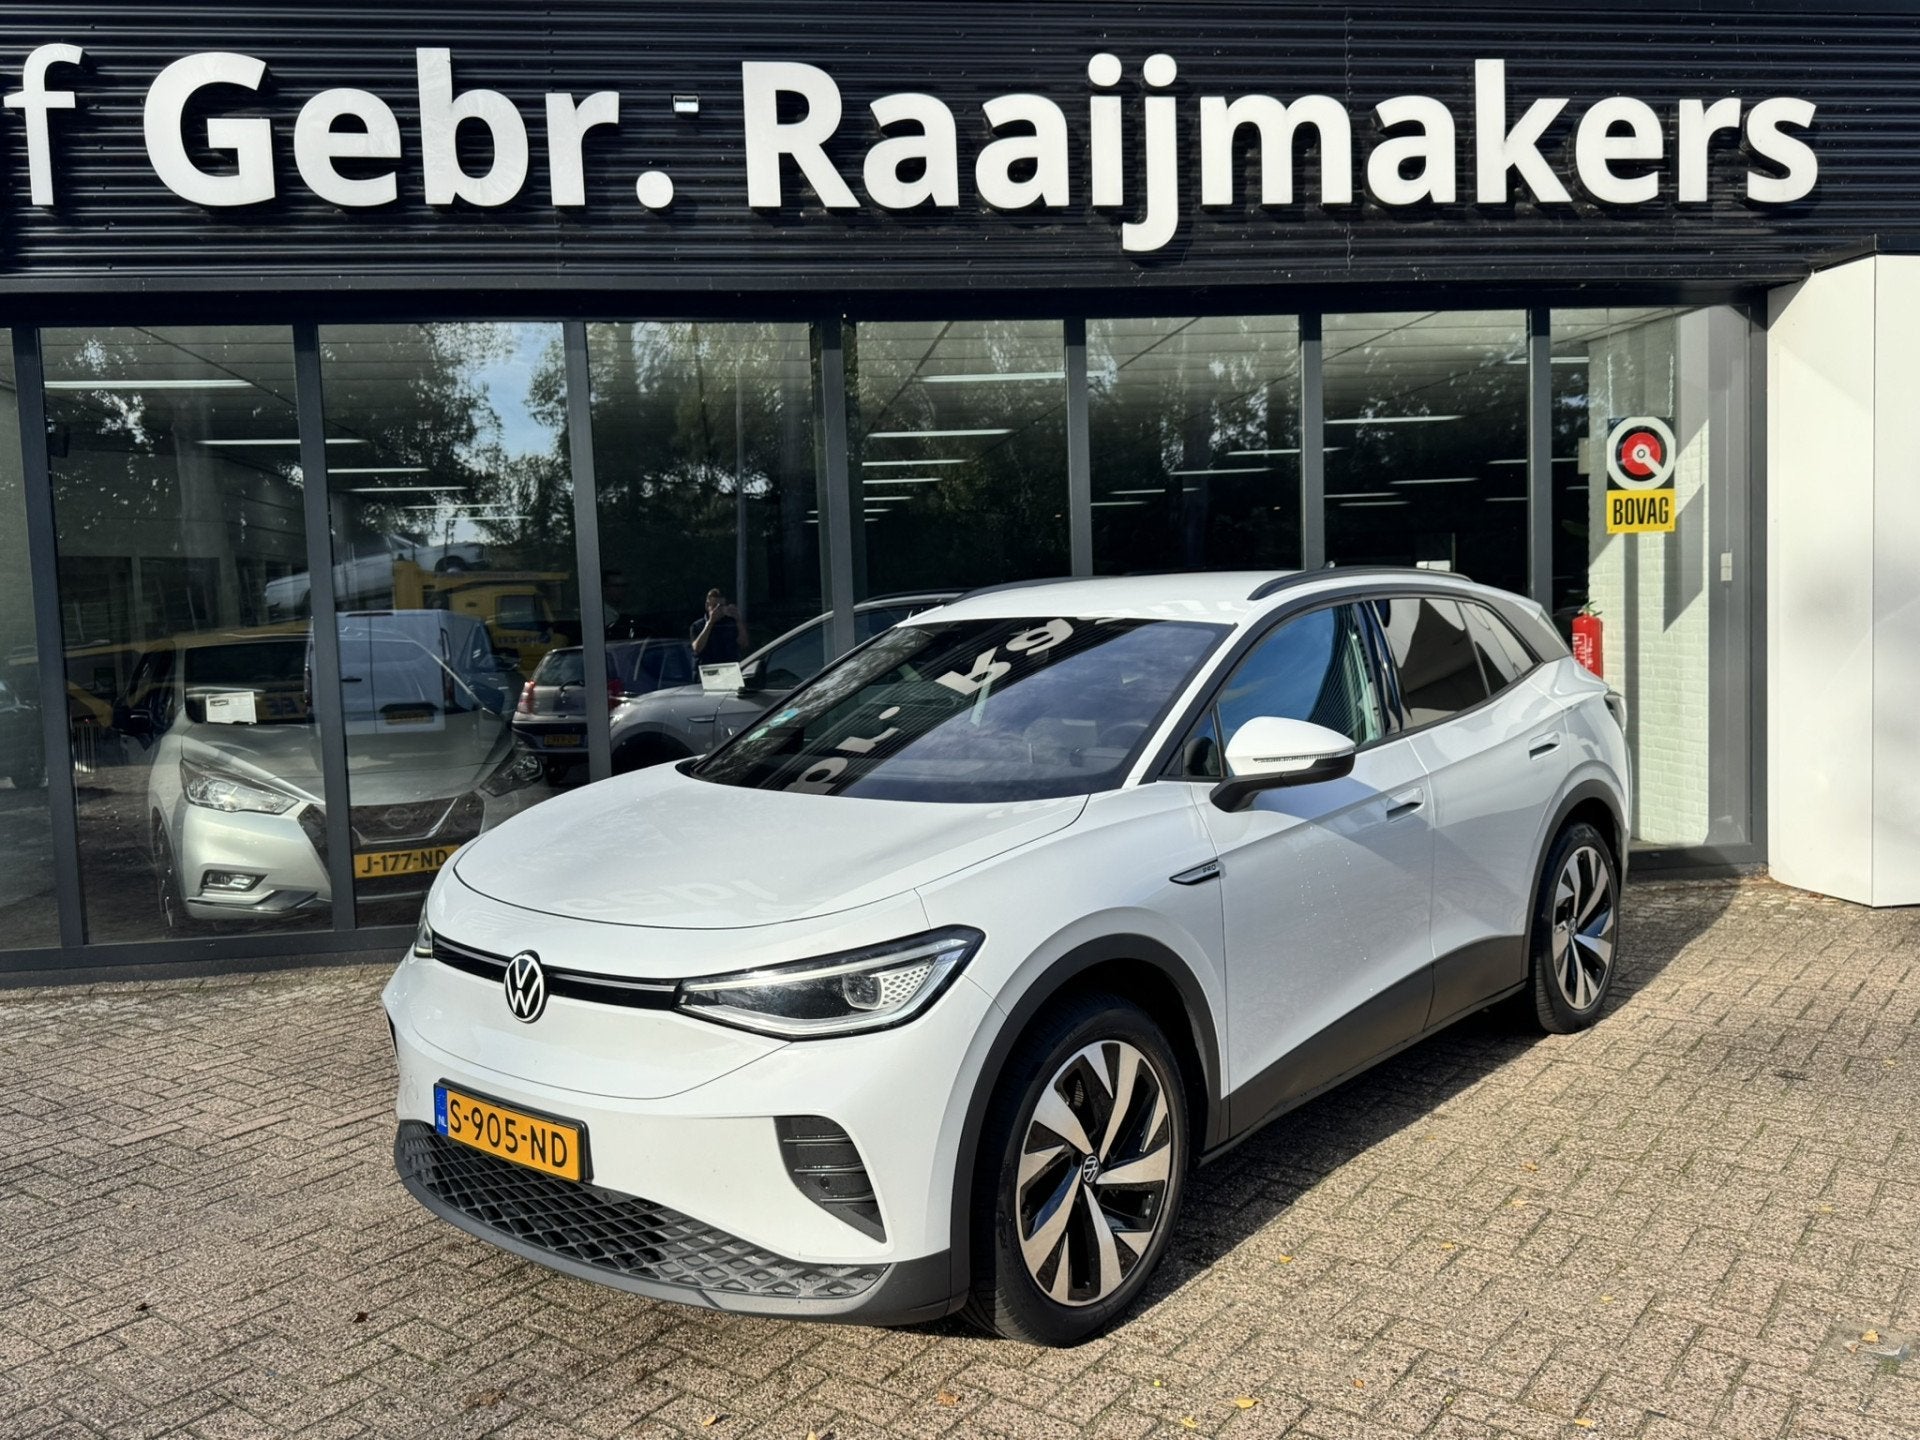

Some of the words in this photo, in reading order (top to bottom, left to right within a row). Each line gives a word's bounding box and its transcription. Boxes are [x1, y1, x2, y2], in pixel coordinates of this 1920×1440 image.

[3, 43, 83, 206] f
[143, 47, 674, 209] Gebr.
[742, 53, 1818, 251] Raaijmakers
[1612, 497, 1669, 526] BOVAG
[362, 849, 448, 873] J-177-ND
[450, 1099, 567, 1168] S-905-ND
